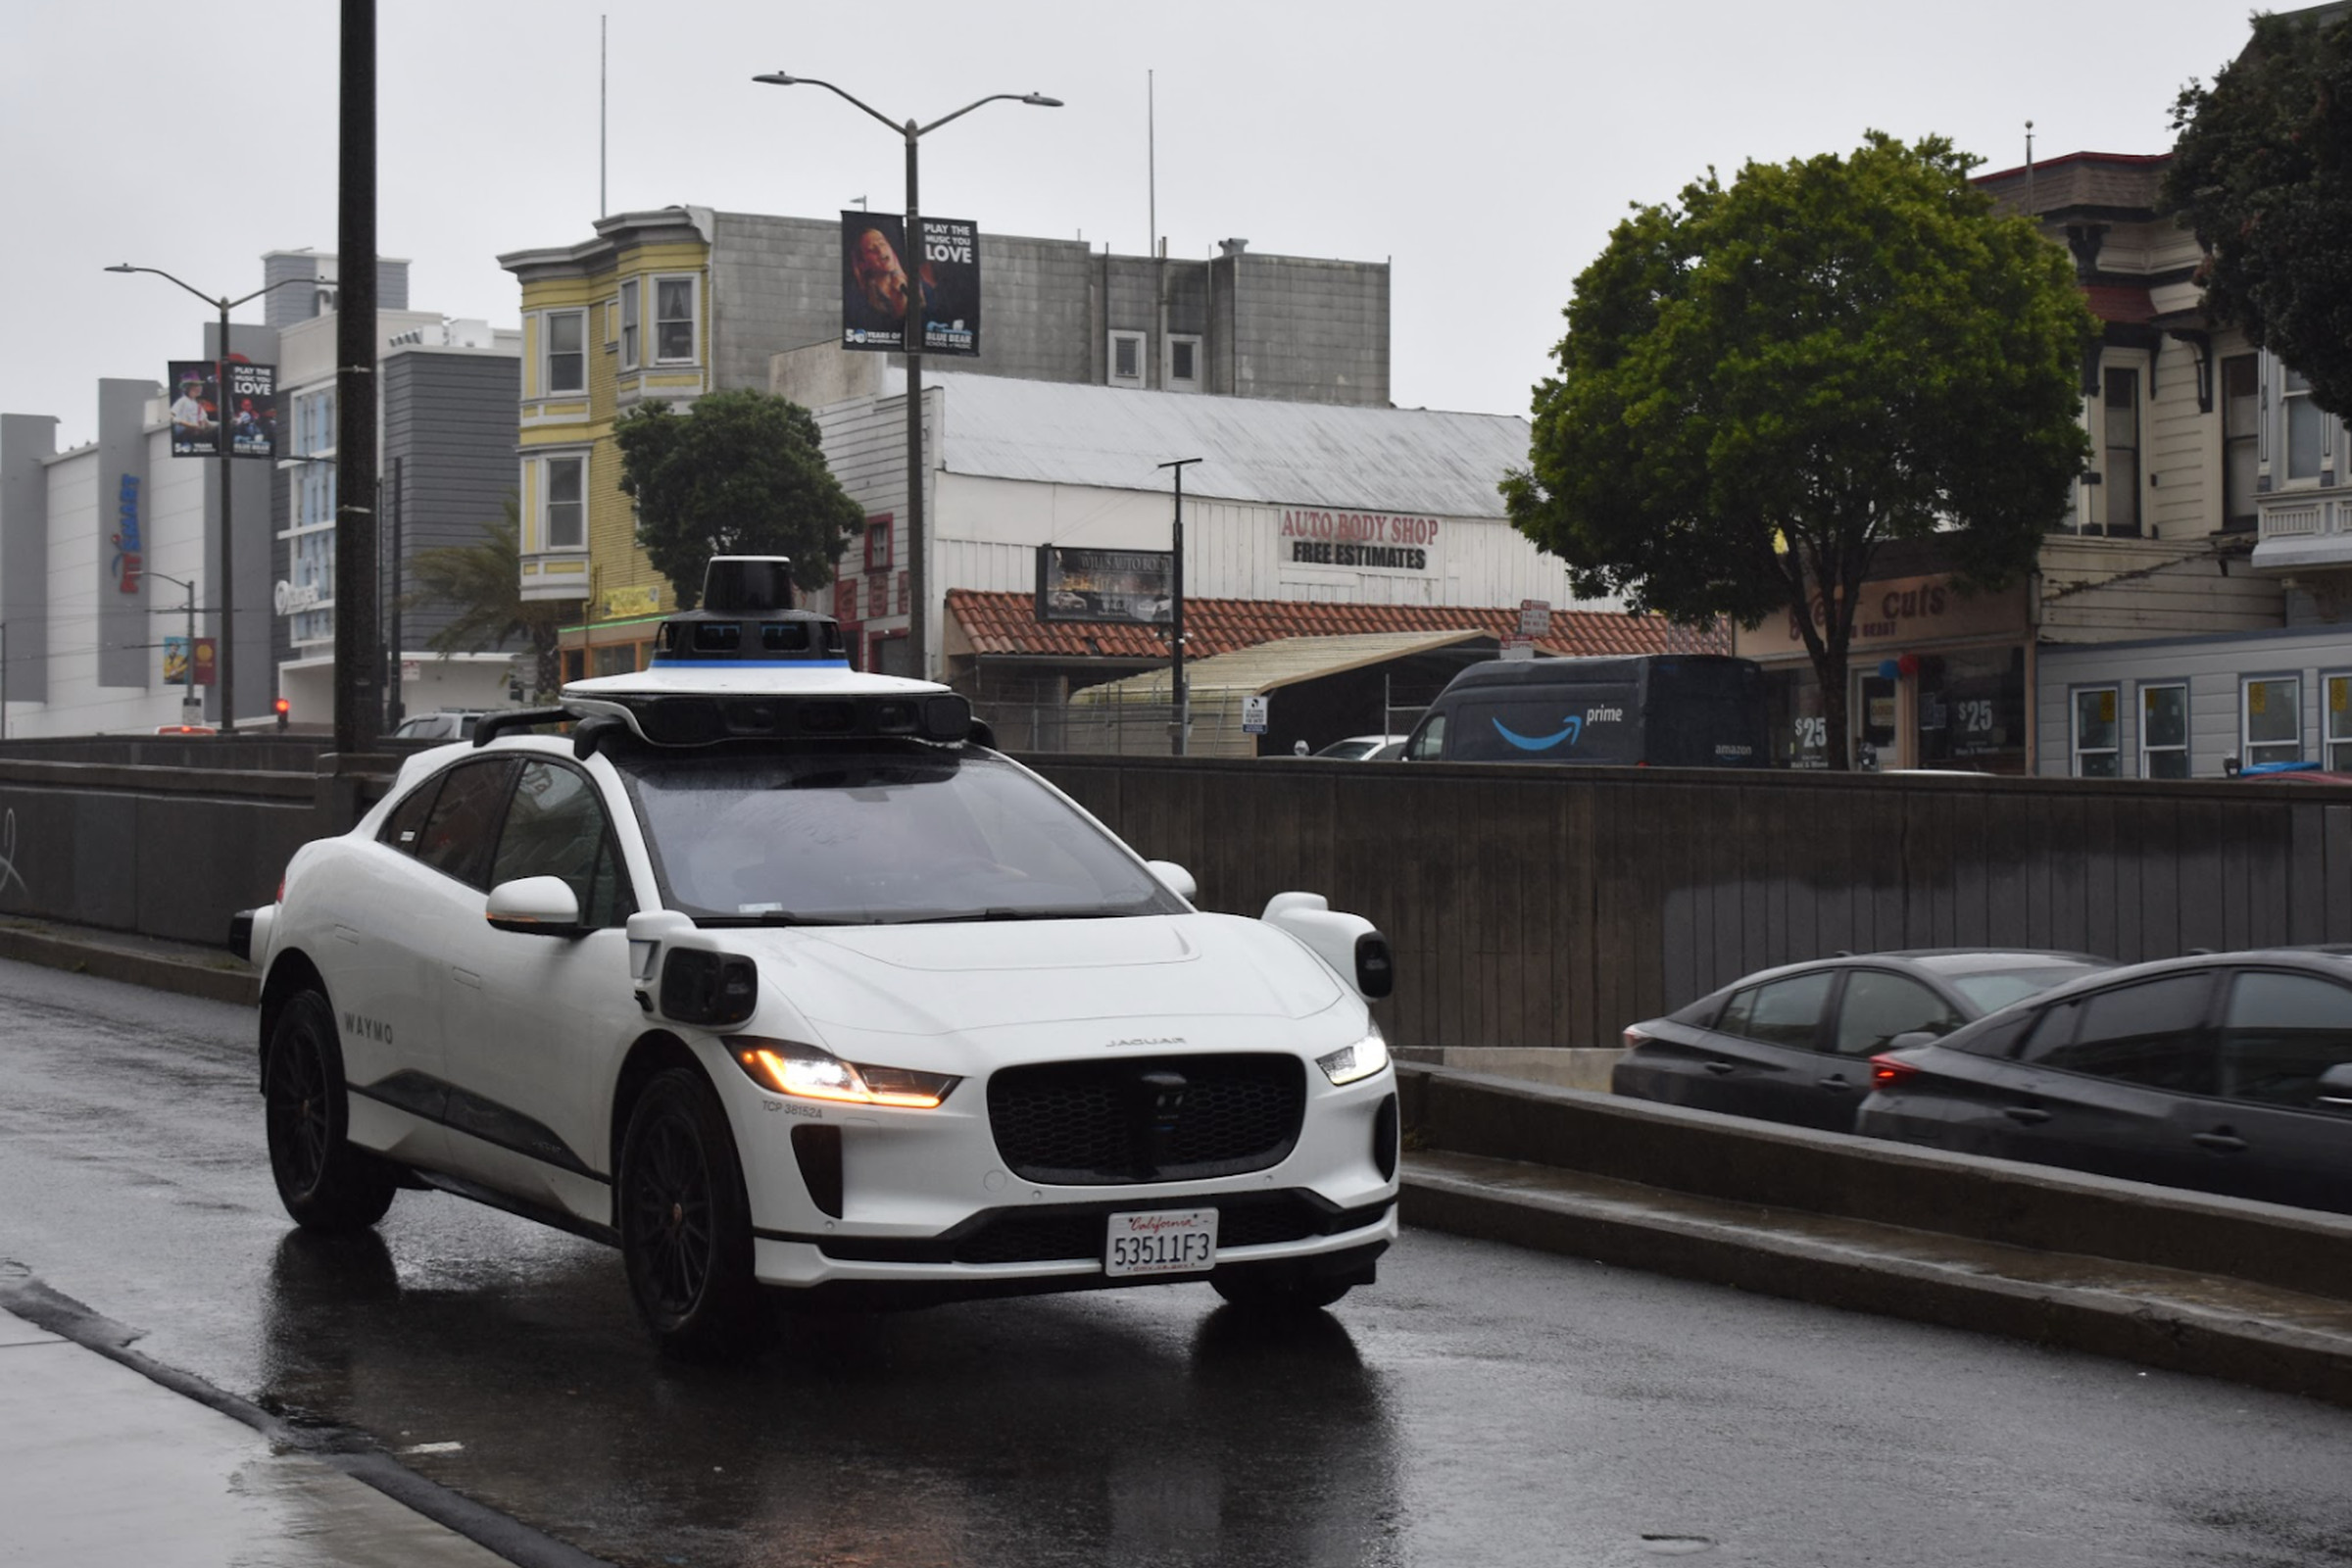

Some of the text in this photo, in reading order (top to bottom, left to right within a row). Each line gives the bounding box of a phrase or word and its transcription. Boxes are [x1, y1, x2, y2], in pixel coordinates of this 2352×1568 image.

[923, 222, 970, 236] PLAY THE
[924, 234, 971, 246] MUSIC YOU
[924, 244, 972, 264] LOVE
[925, 331, 972, 344] BLUE BEAR
[234, 366, 271, 376] PLAY THE
[234, 381, 271, 396] LOVE
[1281, 510, 1439, 546] AUTO BODY SHOP
[1292, 541, 1427, 570] FREE ESTIMATES
[1586, 704, 1623, 726] prime
[1958, 700, 1993, 733] $25
[1794, 717, 1828, 749] $25
[1715, 745, 1752, 756] amazon
[343, 1011, 394, 1046] WAYMO
[1105, 1038, 1188, 1048] JAGUAR
[762, 1100, 823, 1119] TCP 38152A
[1131, 1216, 1194, 1234] California
[1114, 1233, 1210, 1266] 53511F3
